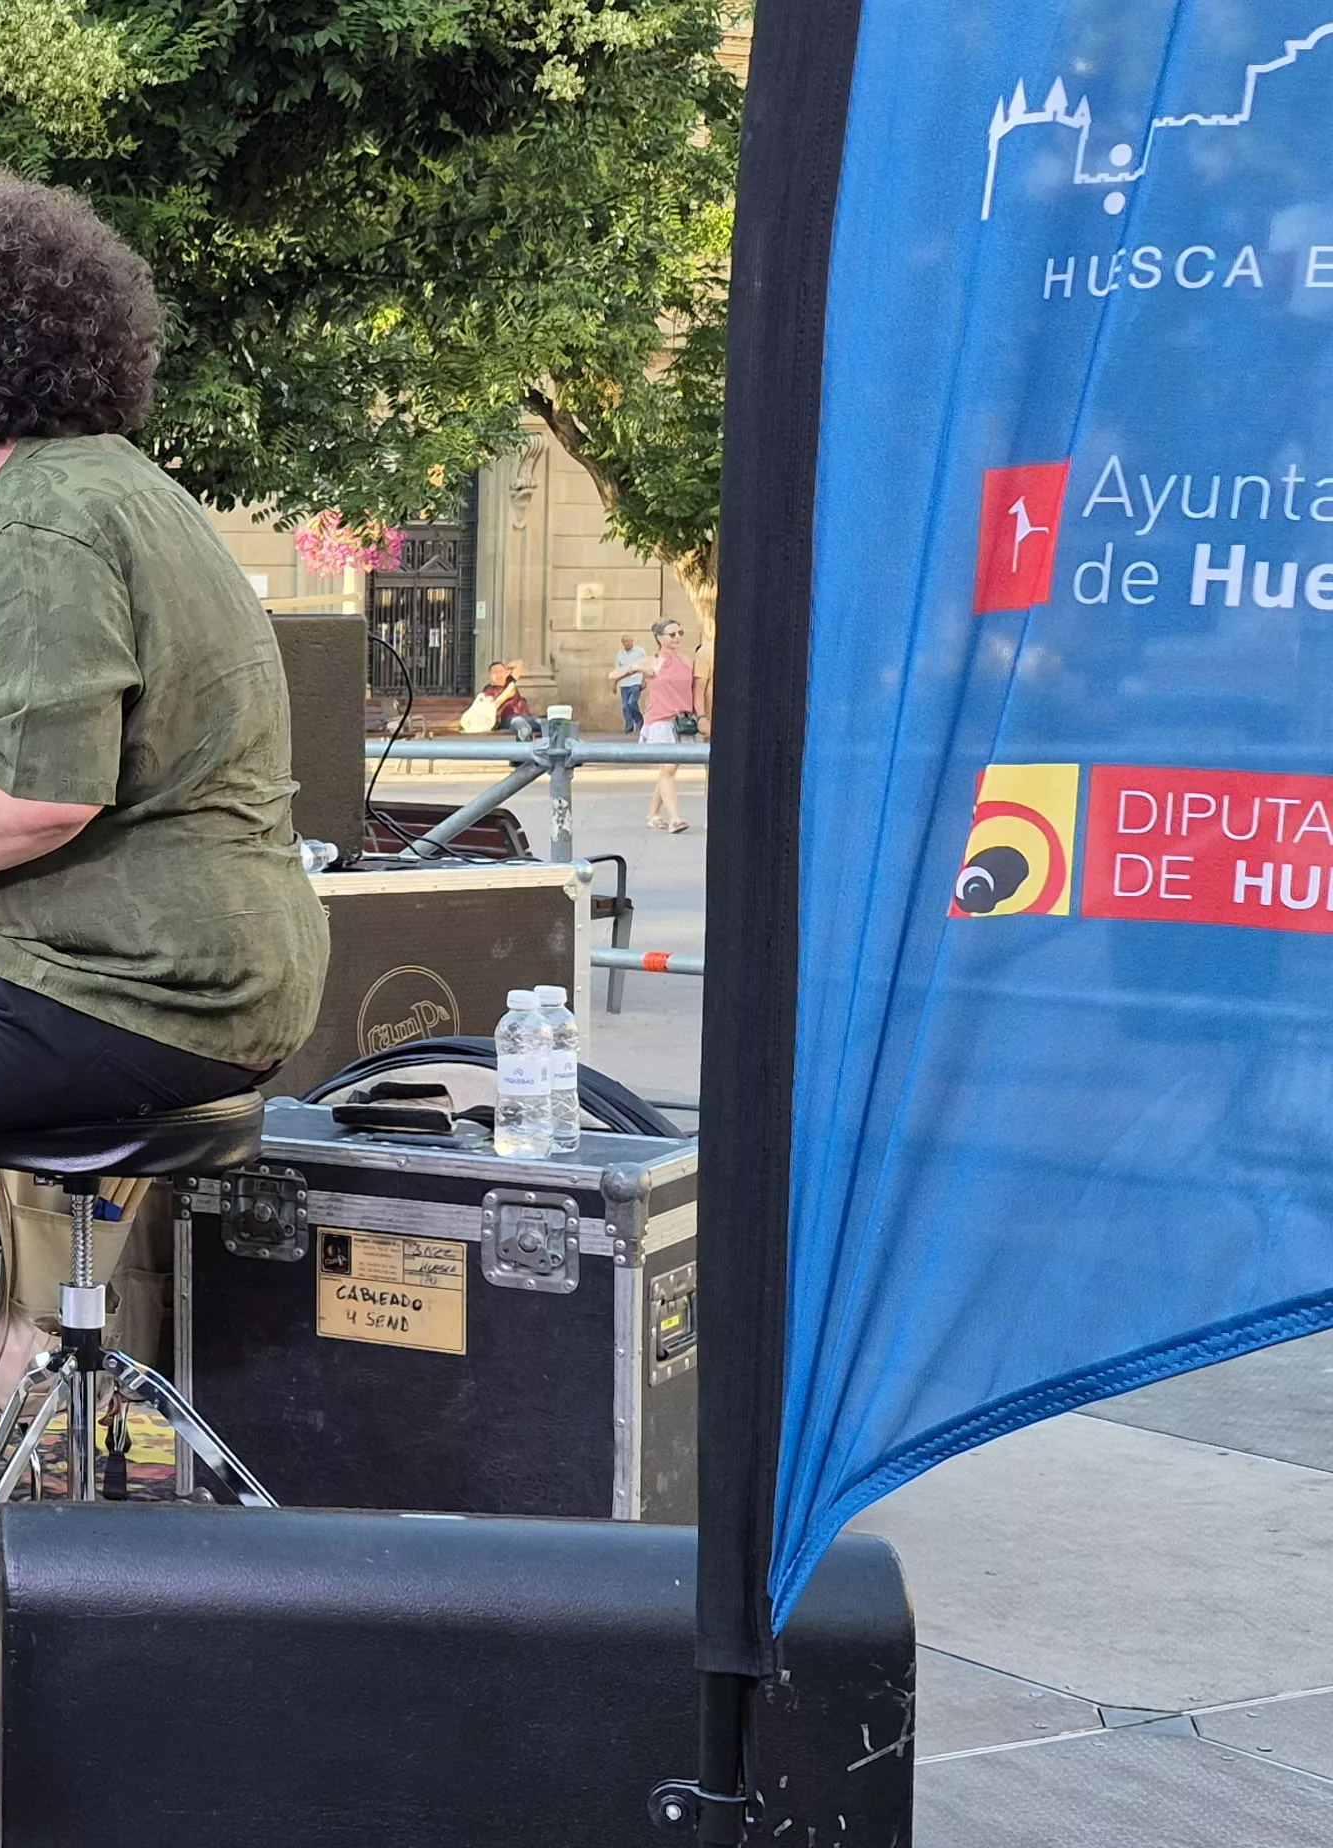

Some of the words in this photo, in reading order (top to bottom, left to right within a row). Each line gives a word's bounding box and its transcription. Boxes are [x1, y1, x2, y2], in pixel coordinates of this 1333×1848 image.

[1043, 245, 1263, 300] HUESCA
[1081, 455, 1333, 536] Ayunta
[1073, 542, 1159, 605] de
[1190, 543, 1333, 610] Hue
[1117, 790, 1333, 846] DIPUTA
[1113, 853, 1194, 900] DE
[1233, 859, 1333, 911] HU
[336, 1285, 423, 1311] CABLEADO
[365, 1312, 410, 1333] SEND
